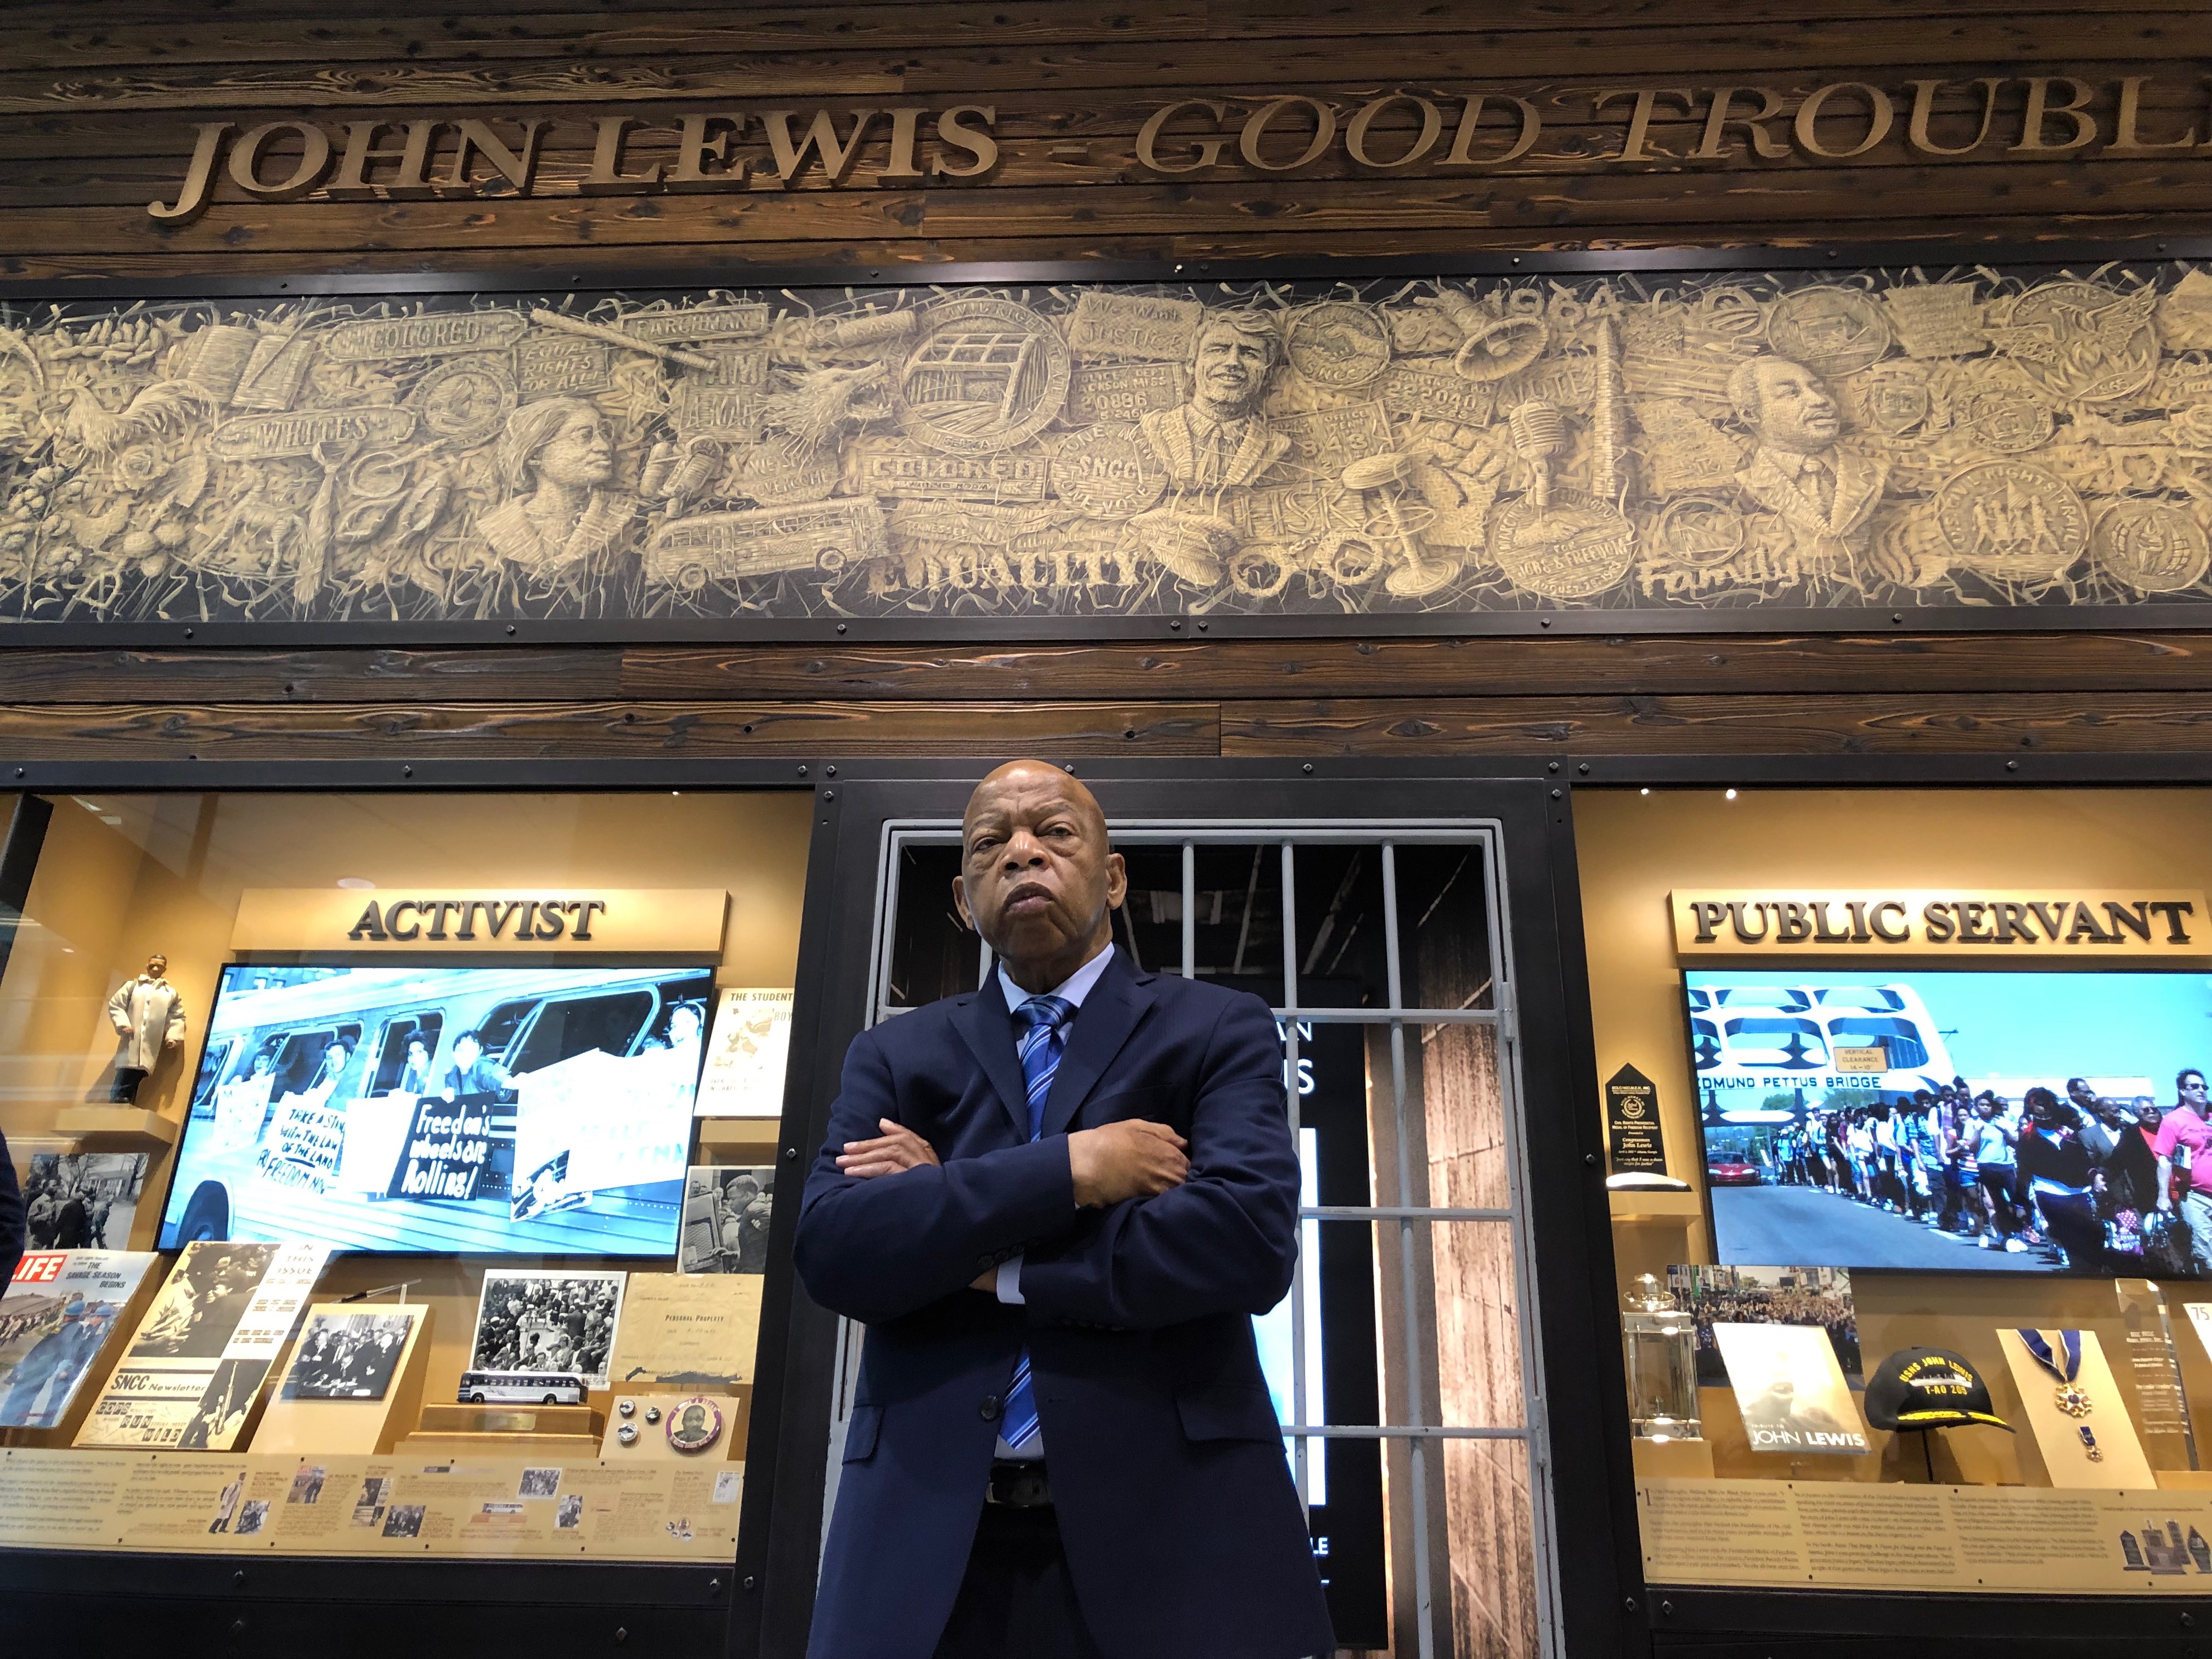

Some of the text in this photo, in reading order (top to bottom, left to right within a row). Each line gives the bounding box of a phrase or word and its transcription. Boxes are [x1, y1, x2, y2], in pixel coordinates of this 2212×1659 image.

[147, 118, 549, 226] JOHN
[579, 104, 1000, 192] LEWIS
[1136, 94, 1543, 173] GOOD
[1594, 74, 2212, 163] TROUBL
[370, 320, 483, 351] COLORED
[525, 342, 589, 361] EQUAL
[524, 357, 592, 377] RIGHTS
[1073, 368, 1166, 385] POLICE DEPT
[1133, 377, 1167, 389] MISS
[521, 379, 549, 392] FOR
[1079, 454, 1137, 479] SNCC
[1564, 537, 1628, 567] FREEDOM
[348, 900, 605, 941] ACTIVIST
[1690, 900, 2194, 946] PUBLIC SERVANT
[731, 992, 794, 1001] THE STUDENT
[1763, 1077, 1817, 1088] PETTUS
[1826, 1076, 1882, 1088] BRIDGE
[289, 1108, 318, 1125] TAKE
[416, 1103, 490, 1136] Freedom's
[12, 1256, 64, 1280] IFE
[92, 1271, 122, 1279] SEASON
[99, 1280, 127, 1289] BEGINS
[1898, 1356, 1974, 1383] USNS JOHN LEWIS
[110, 1374, 207, 1392] SNCC Newsletter
[1923, 1385, 1968, 1396] T-AO 205
[95, 1402, 133, 1415] COPS
[119, 1415, 154, 1429] RUN
[140, 1427, 183, 1442] WILD
[1752, 1430, 1866, 1447] JOHN LEWIS
